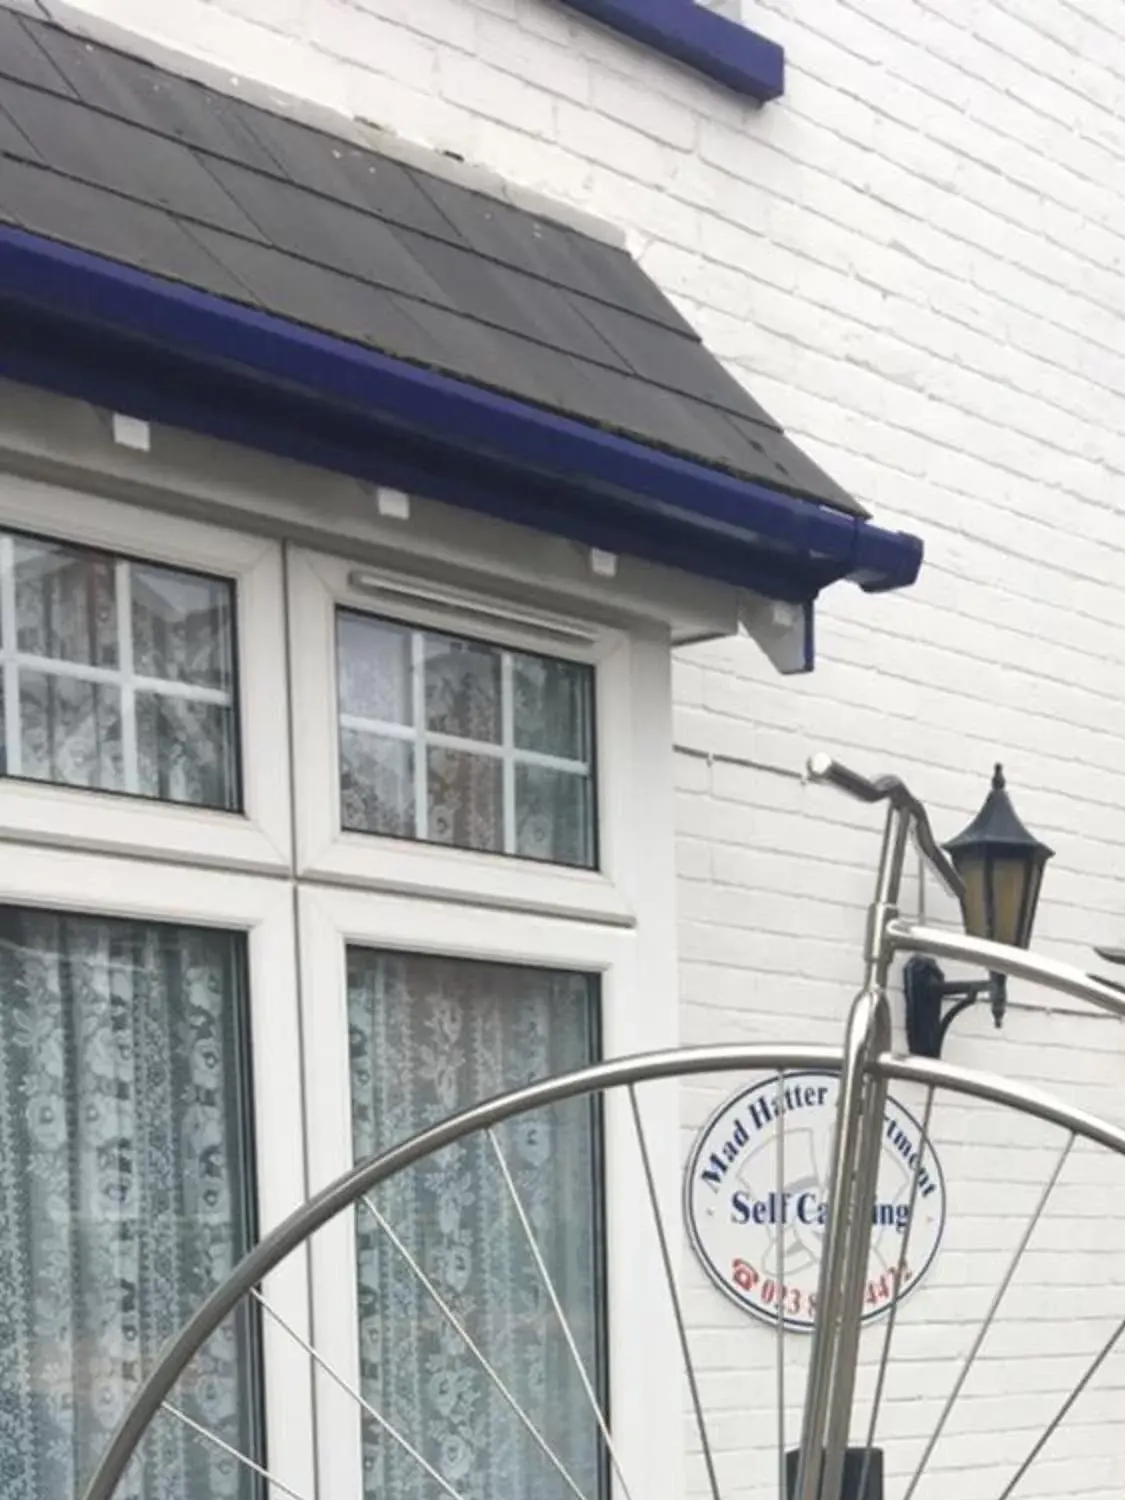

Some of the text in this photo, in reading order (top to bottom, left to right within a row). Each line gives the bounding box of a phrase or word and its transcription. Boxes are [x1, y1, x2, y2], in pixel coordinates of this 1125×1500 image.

[700, 1120, 751, 1194] Mad
[747, 1085, 829, 1130] Hatter
[730, 1190, 792, 1225] Self
